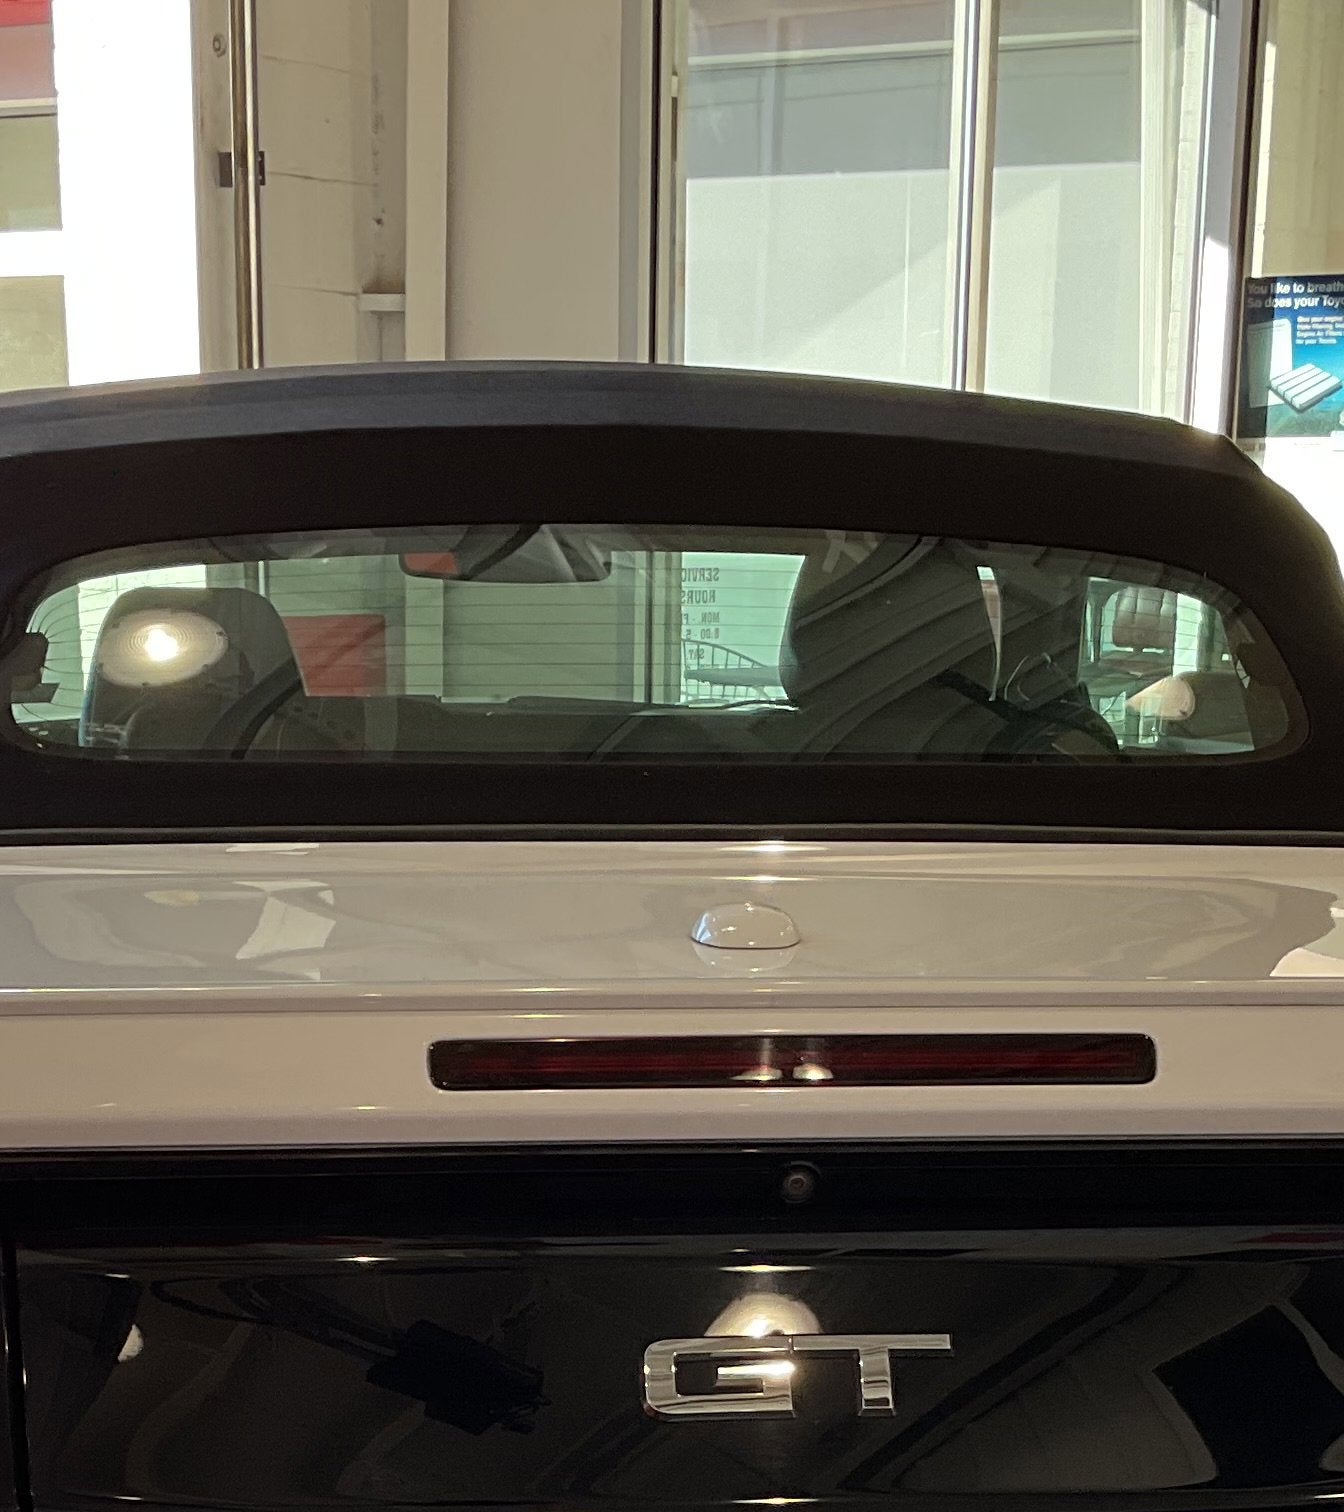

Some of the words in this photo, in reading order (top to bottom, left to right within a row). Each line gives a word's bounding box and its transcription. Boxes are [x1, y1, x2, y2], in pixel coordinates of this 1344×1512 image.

[1248, 284, 1267, 294] You
[1293, 283, 1305, 293] to
[1247, 298, 1262, 308] So
[1265, 297, 1292, 308] does
[1294, 297, 1319, 309] your
[643, 1333, 954, 1422] GT
